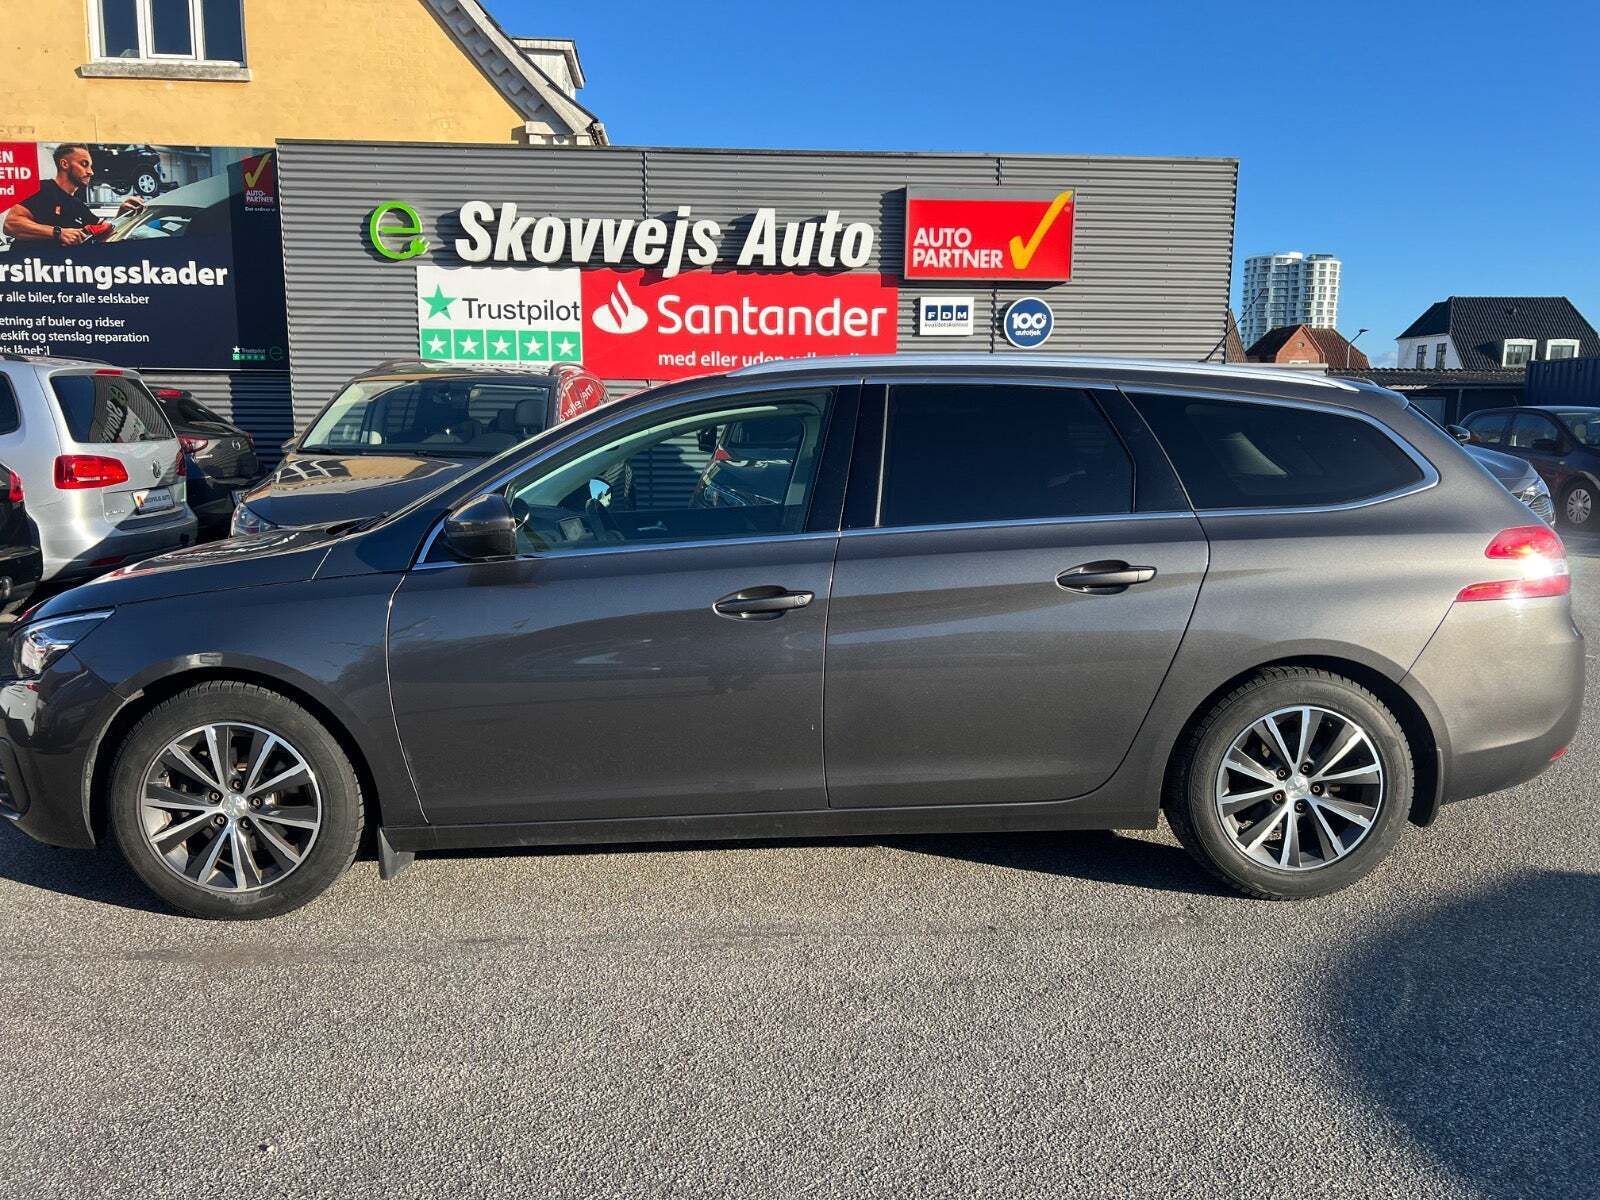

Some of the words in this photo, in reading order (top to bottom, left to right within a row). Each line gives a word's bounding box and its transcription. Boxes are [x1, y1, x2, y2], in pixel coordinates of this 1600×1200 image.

[0, 151, 14, 163] N
[455, 200, 721, 278] Skovvejs
[736, 208, 875, 267] Auto
[913, 228, 972, 248] AUTO
[912, 249, 1004, 269] PARTNER
[6, 291, 26, 303] alle
[28, 292, 56, 304] biler,
[58, 292, 74, 303] for
[76, 292, 96, 304] alle
[97, 292, 150, 304] selskaber
[462, 298, 581, 325] Trustpilot
[657, 294, 888, 337] Santander
[36, 316, 46, 327] af
[48, 317, 76, 327] buler
[78, 319, 93, 329] og
[95, 317, 126, 328] ridser
[32, 332, 46, 344] og
[48, 331, 93, 344] stenslag
[94, 333, 150, 345] reparation
[658, 351, 696, 367] med
[701, 352, 738, 367] eller
